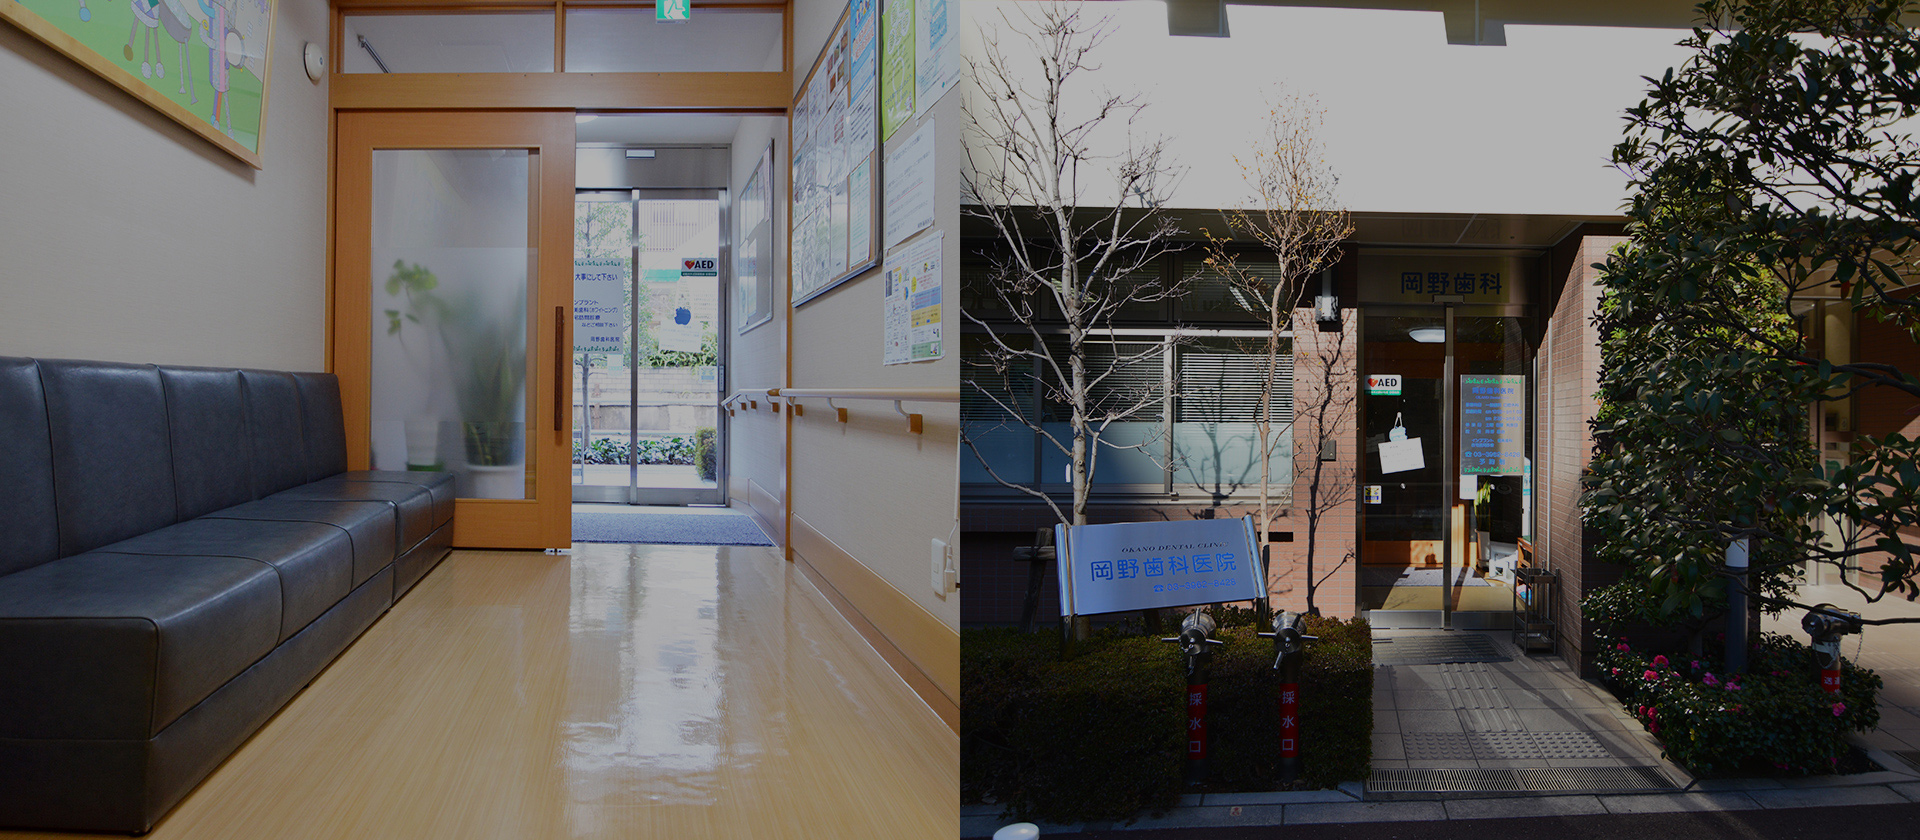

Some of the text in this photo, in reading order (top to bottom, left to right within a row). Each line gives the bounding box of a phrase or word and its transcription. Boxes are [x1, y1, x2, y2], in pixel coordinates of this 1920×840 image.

[694, 260, 714, 269] AED
[1401, 272, 1502, 295] 岡野歯科
[1377, 378, 1397, 387] AED
[1091, 552, 1237, 581] 岡野歯科医院
[1189, 692, 1202, 753] 採水口
[1282, 690, 1295, 751] 採水口
